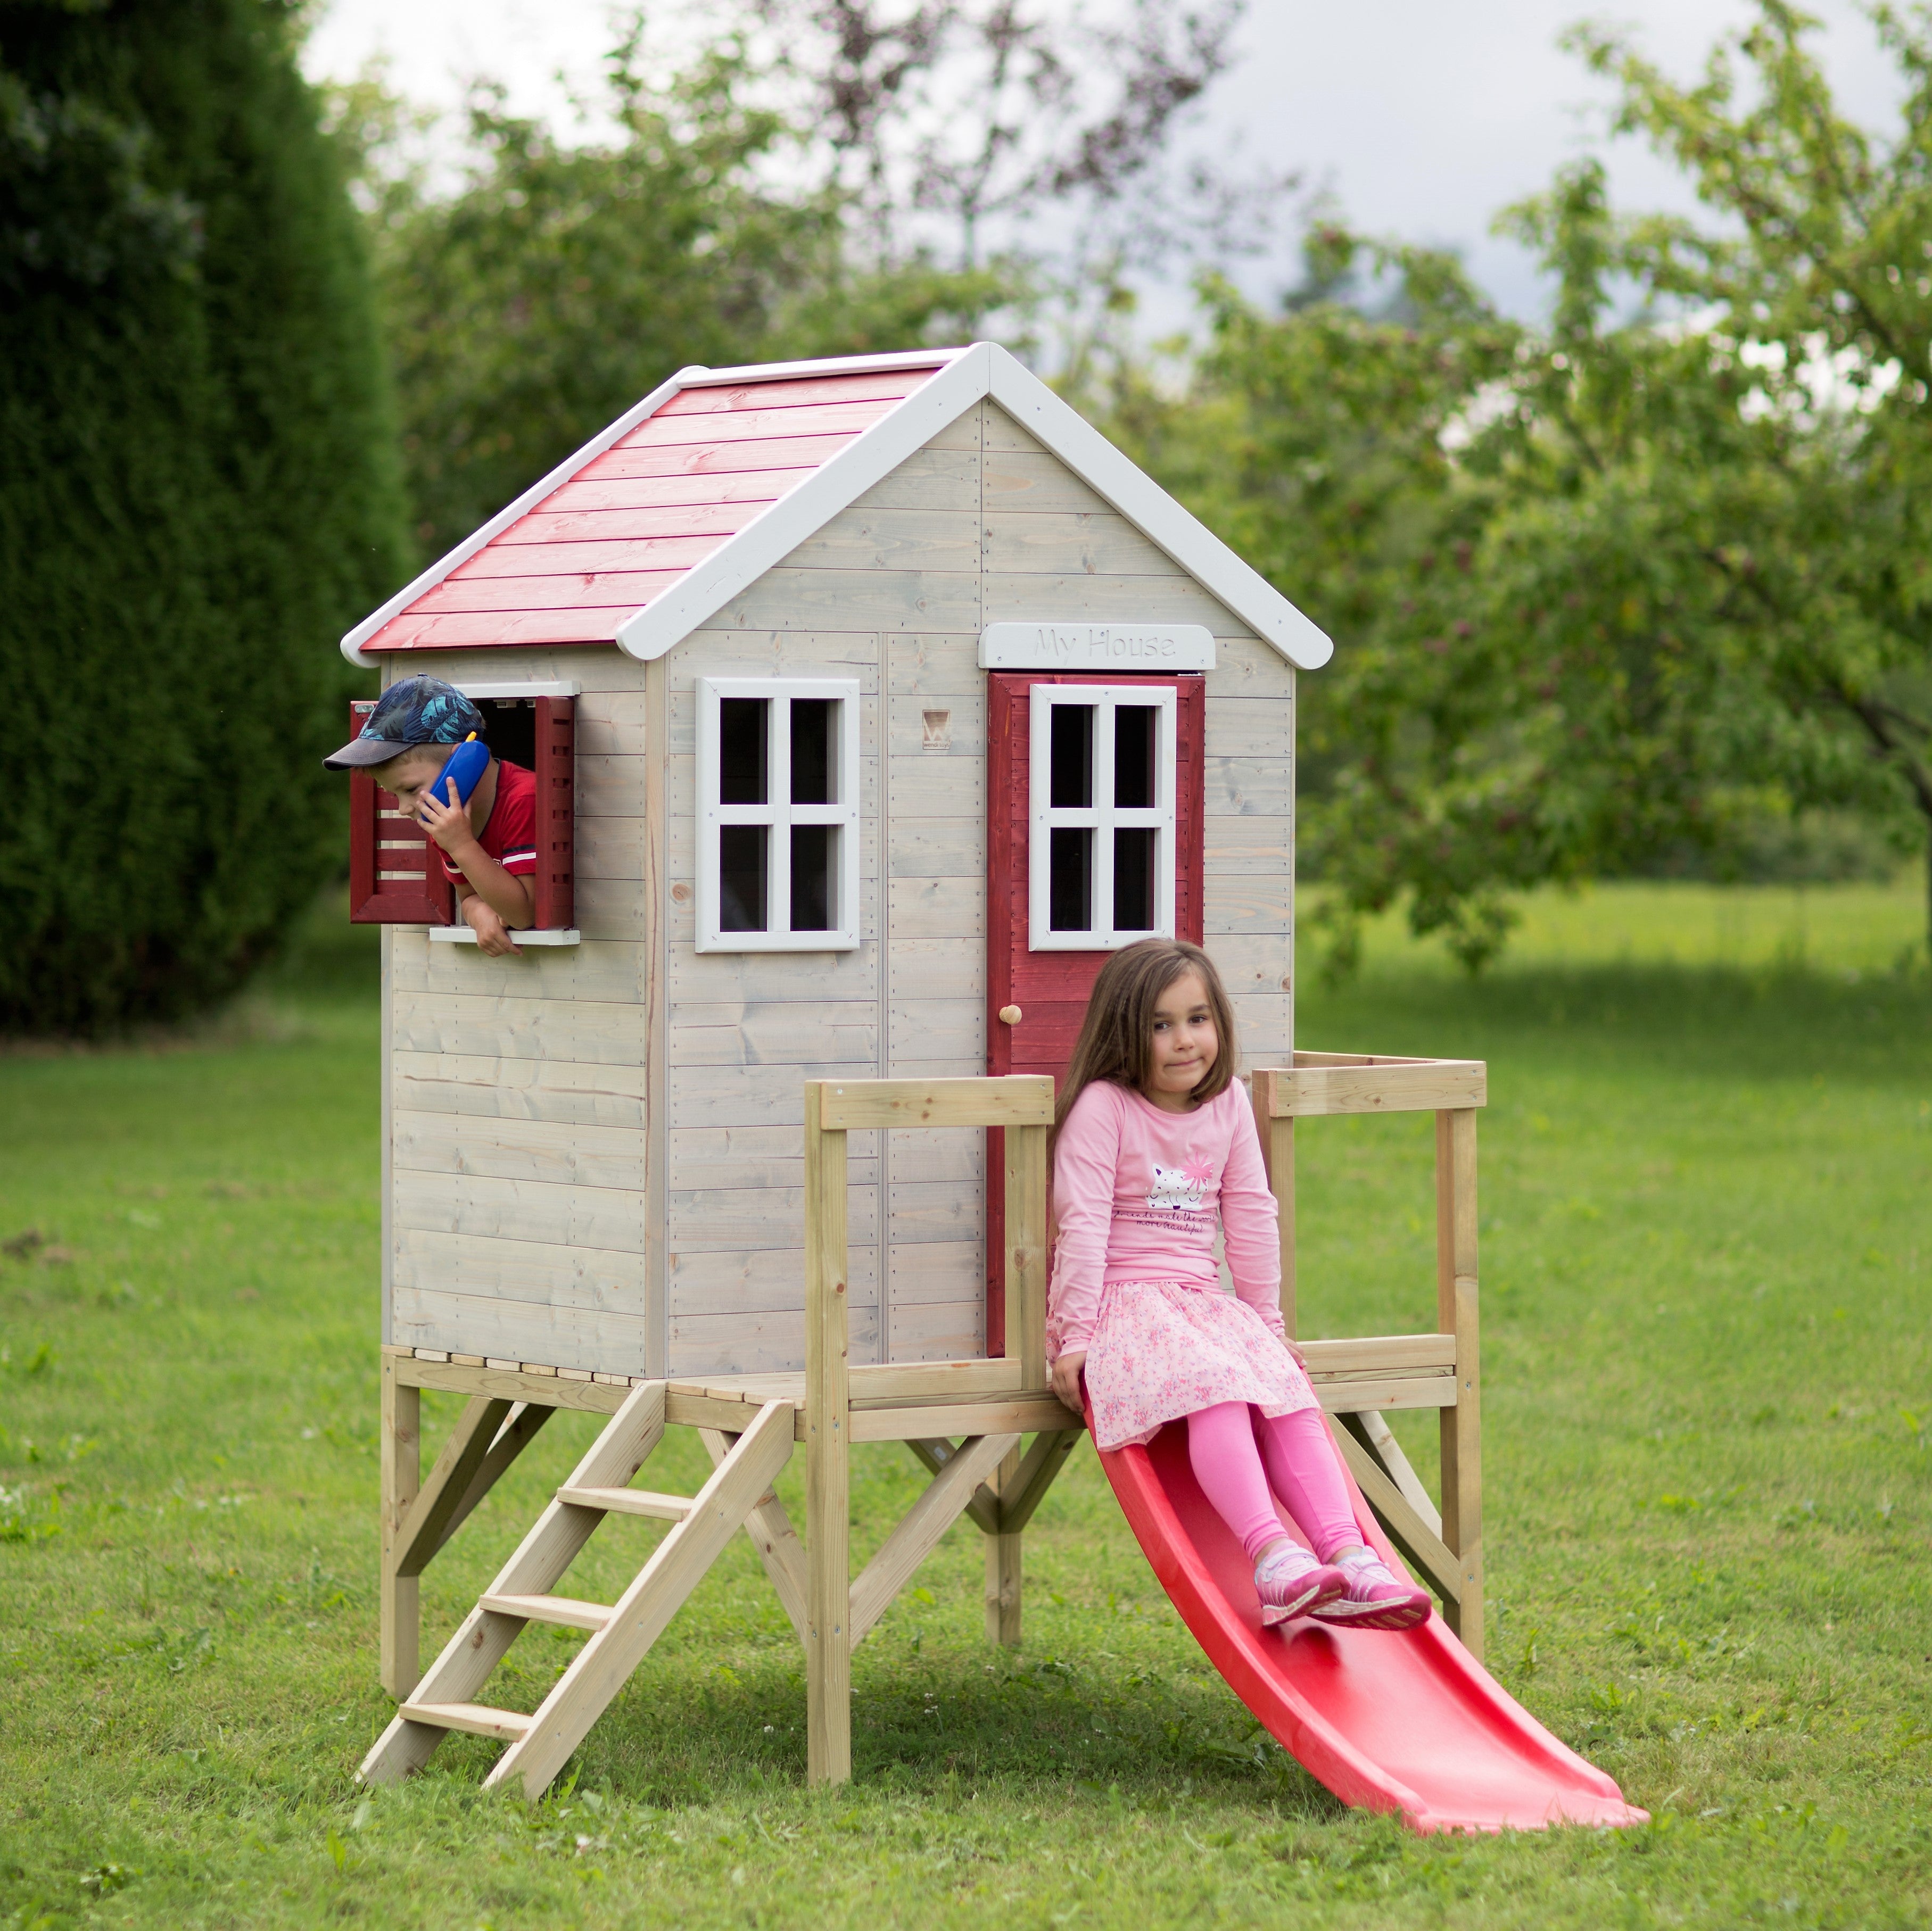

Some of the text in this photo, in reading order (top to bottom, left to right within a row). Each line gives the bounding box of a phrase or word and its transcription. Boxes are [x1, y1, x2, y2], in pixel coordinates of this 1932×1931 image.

[1035, 629, 1176, 666] My House
[1183, 1212, 1197, 1222] the
[1163, 1222, 1204, 1236] beautiful
